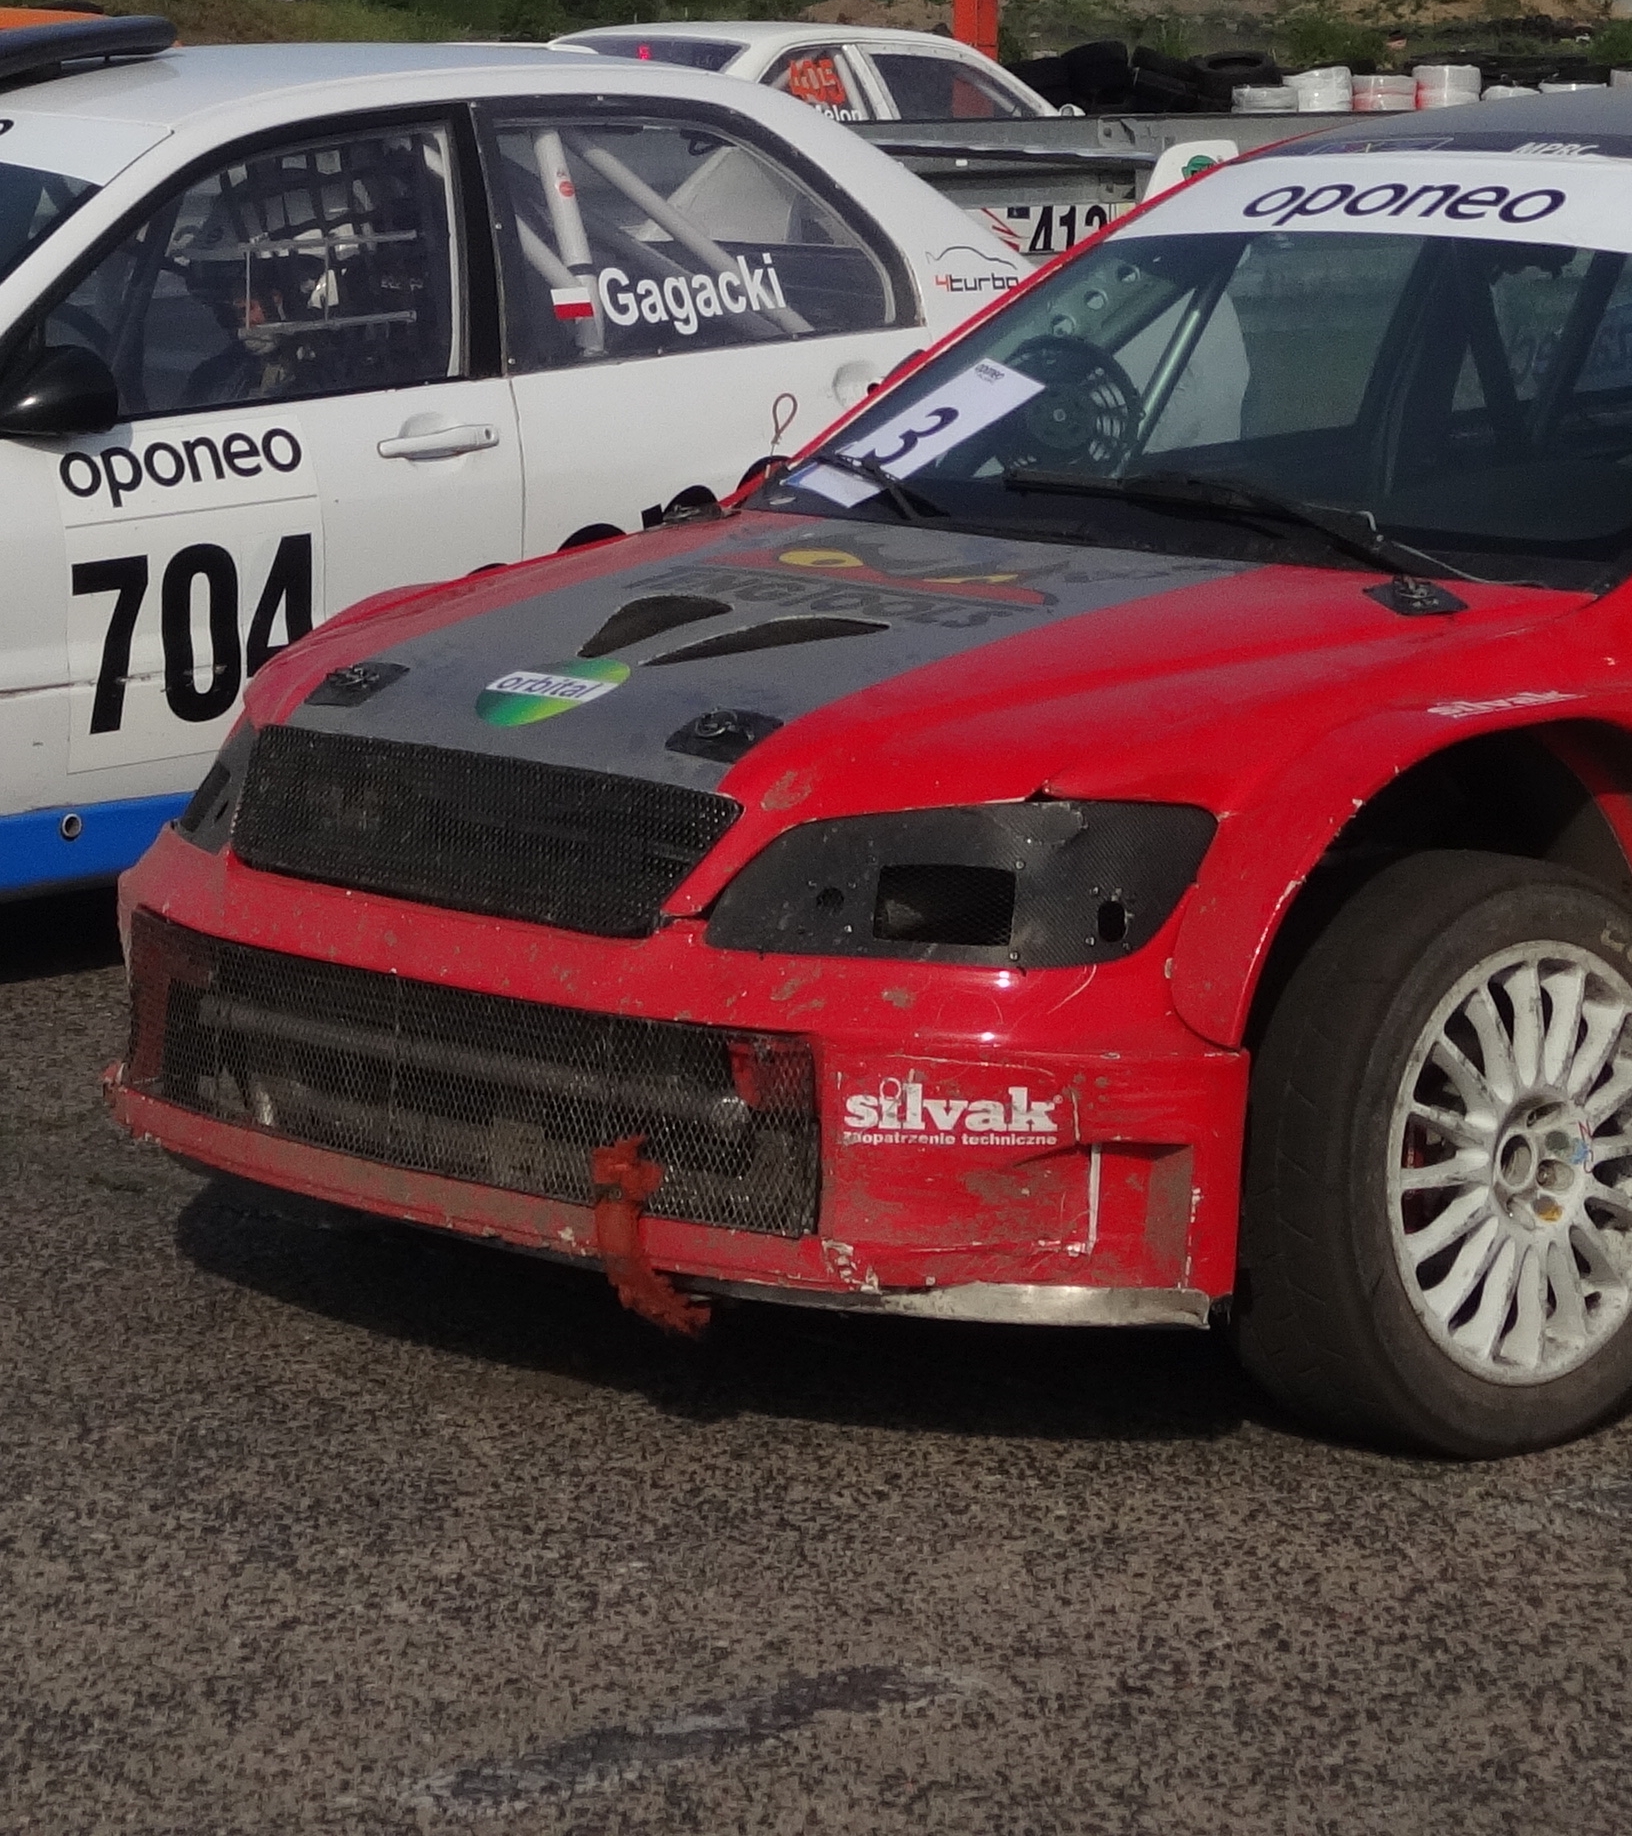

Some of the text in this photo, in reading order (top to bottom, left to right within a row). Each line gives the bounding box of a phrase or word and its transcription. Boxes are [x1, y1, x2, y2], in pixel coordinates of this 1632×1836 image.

[1243, 182, 1566, 226] oponeo
[598, 252, 787, 335] Gagacki
[935, 273, 1019, 293] 4turbo
[863, 406, 960, 465] 3
[59, 427, 302, 508] oponeo
[71, 532, 314, 735] 704
[496, 676, 603, 699] orbital
[844, 1077, 1059, 1132] silvak
[843, 1131, 1058, 1146] zaopatrzenie techniczne
